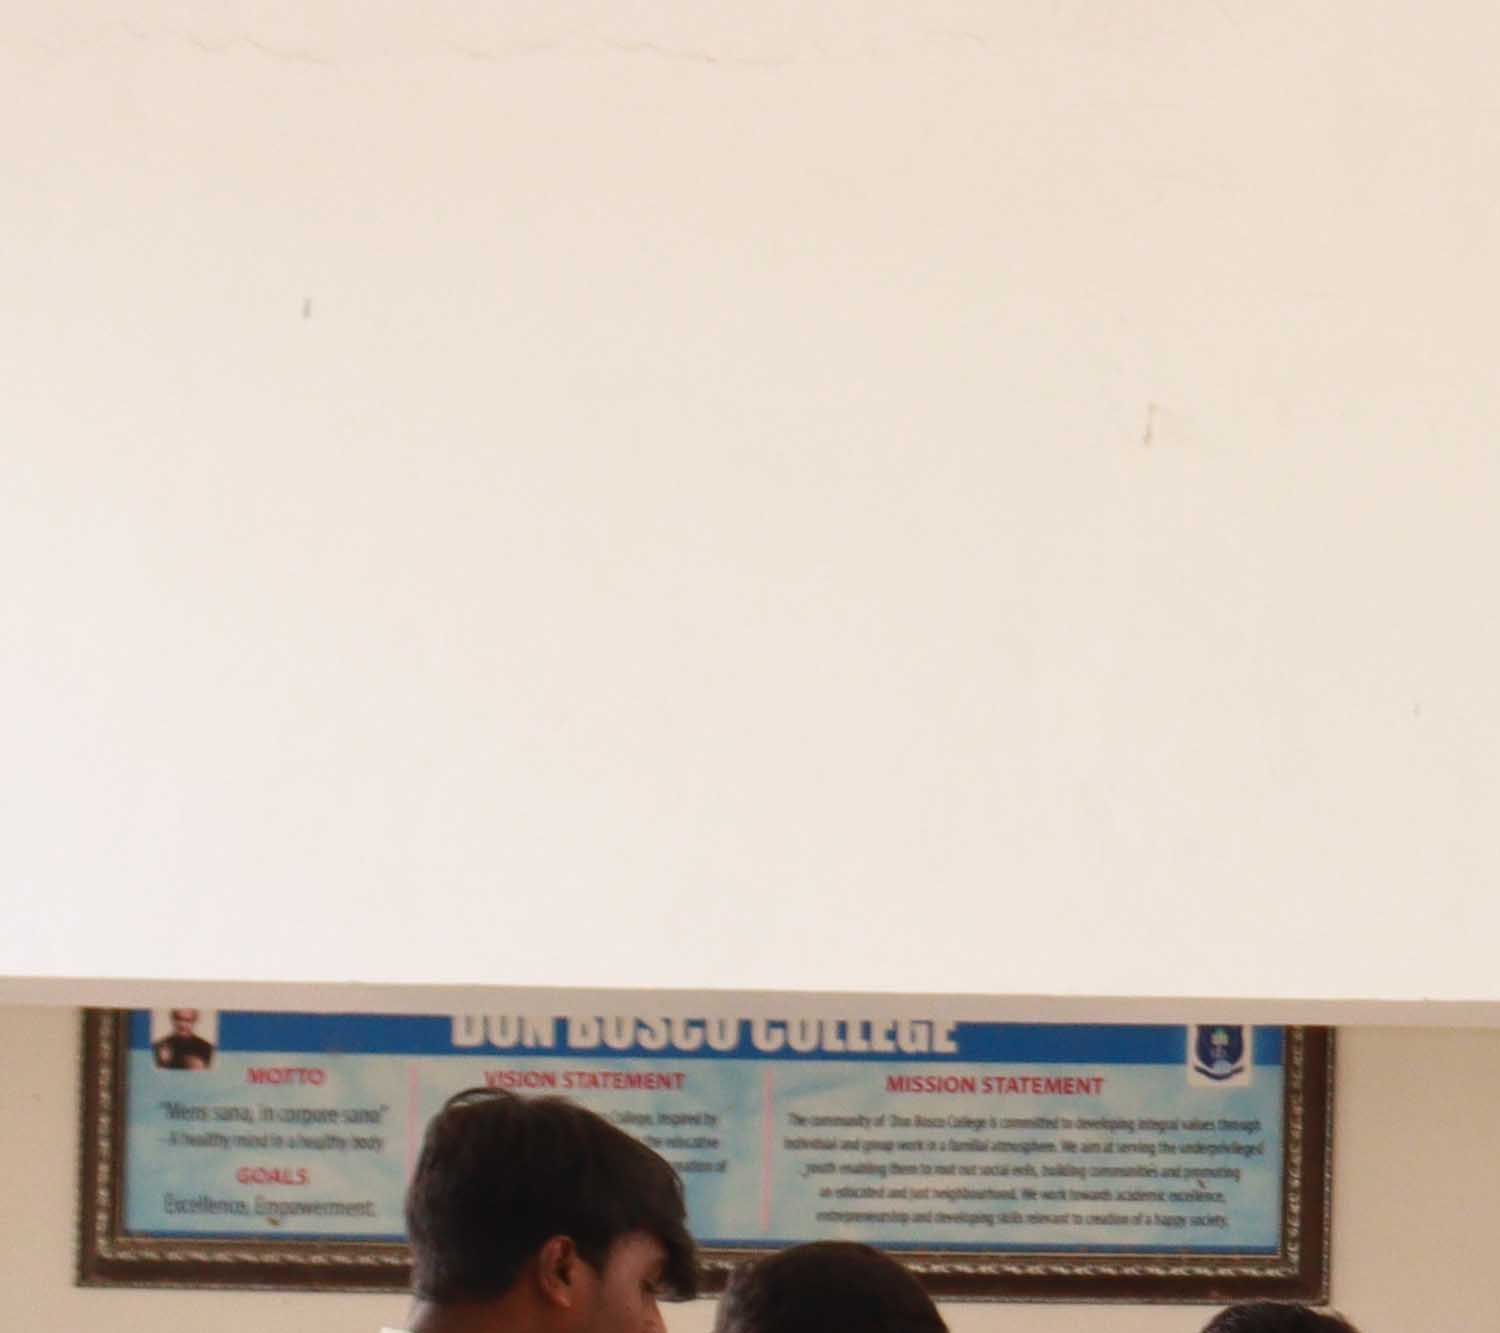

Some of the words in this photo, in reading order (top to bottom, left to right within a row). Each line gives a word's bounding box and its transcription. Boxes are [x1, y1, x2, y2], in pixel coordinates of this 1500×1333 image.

[450, 1014, 557, 1049] DON
[567, 1016, 741, 1051] BOSCO
[750, 1018, 959, 1053] COLLEGE
[245, 1066, 328, 1087] MOTTO
[483, 1070, 553, 1090] VISION
[562, 1071, 686, 1090] STATEMENT
[886, 1075, 977, 1094] MISSION
[981, 1076, 1105, 1095] STATEMENT
[235, 1167, 309, 1186] GOALS
